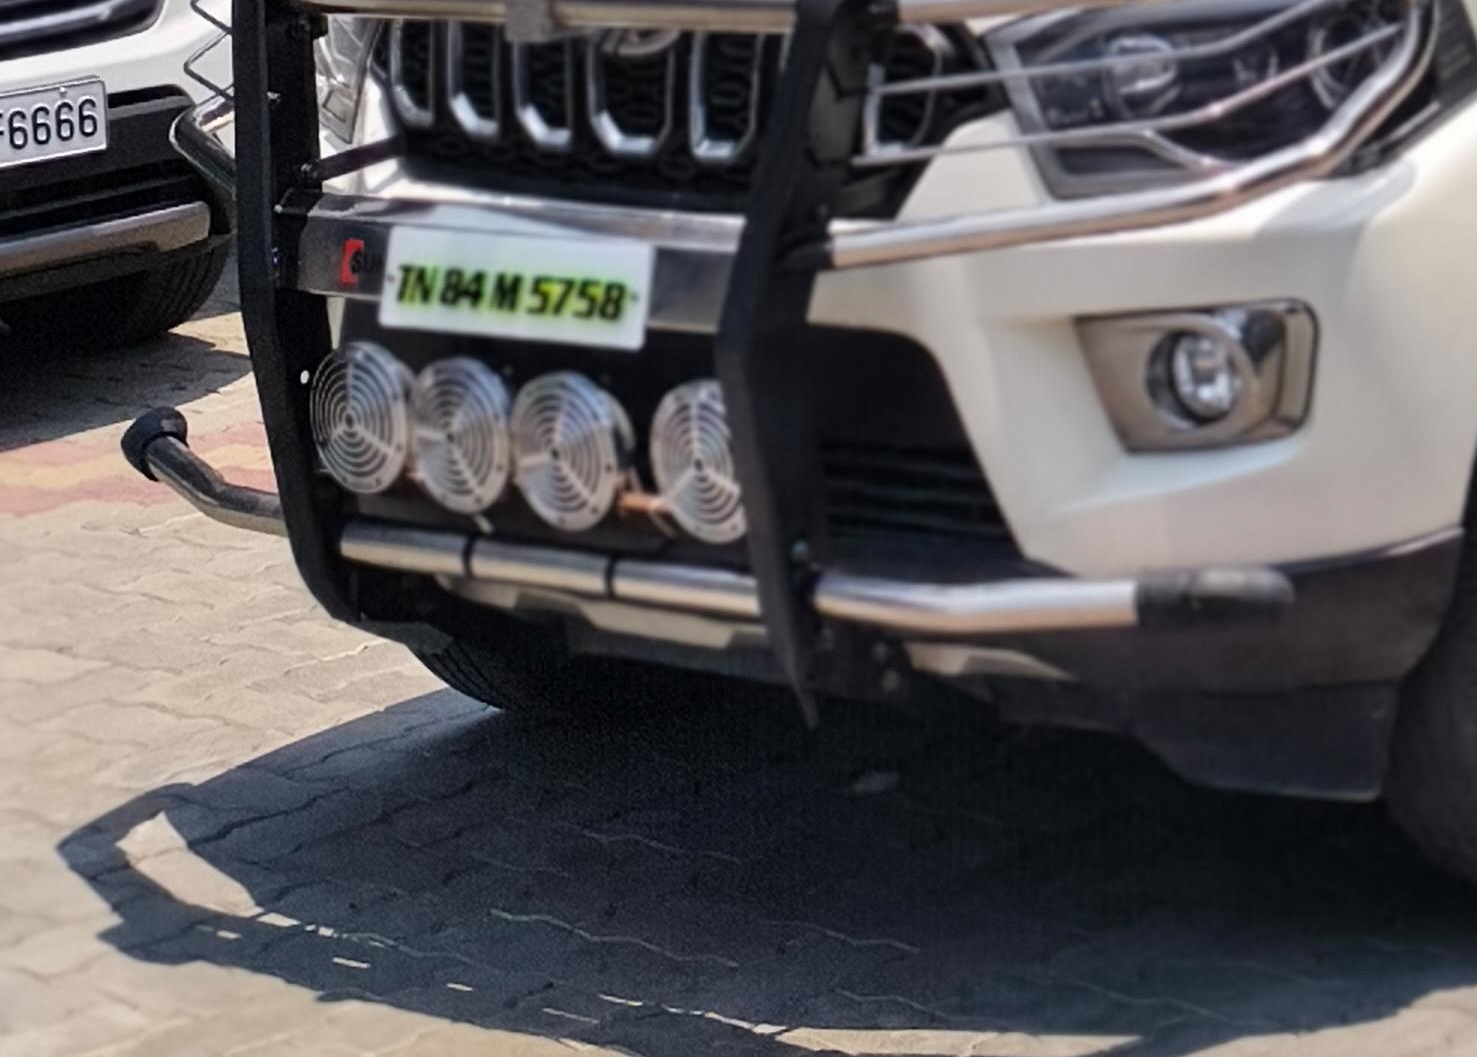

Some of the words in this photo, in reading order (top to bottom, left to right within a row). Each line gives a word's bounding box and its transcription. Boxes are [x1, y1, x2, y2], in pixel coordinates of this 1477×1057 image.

[0, 97, 97, 150] 6666
[396, 263, 438, 304] TN
[440, 268, 484, 310] 84
[490, 270, 522, 313] M
[527, 275, 625, 321] 5758
